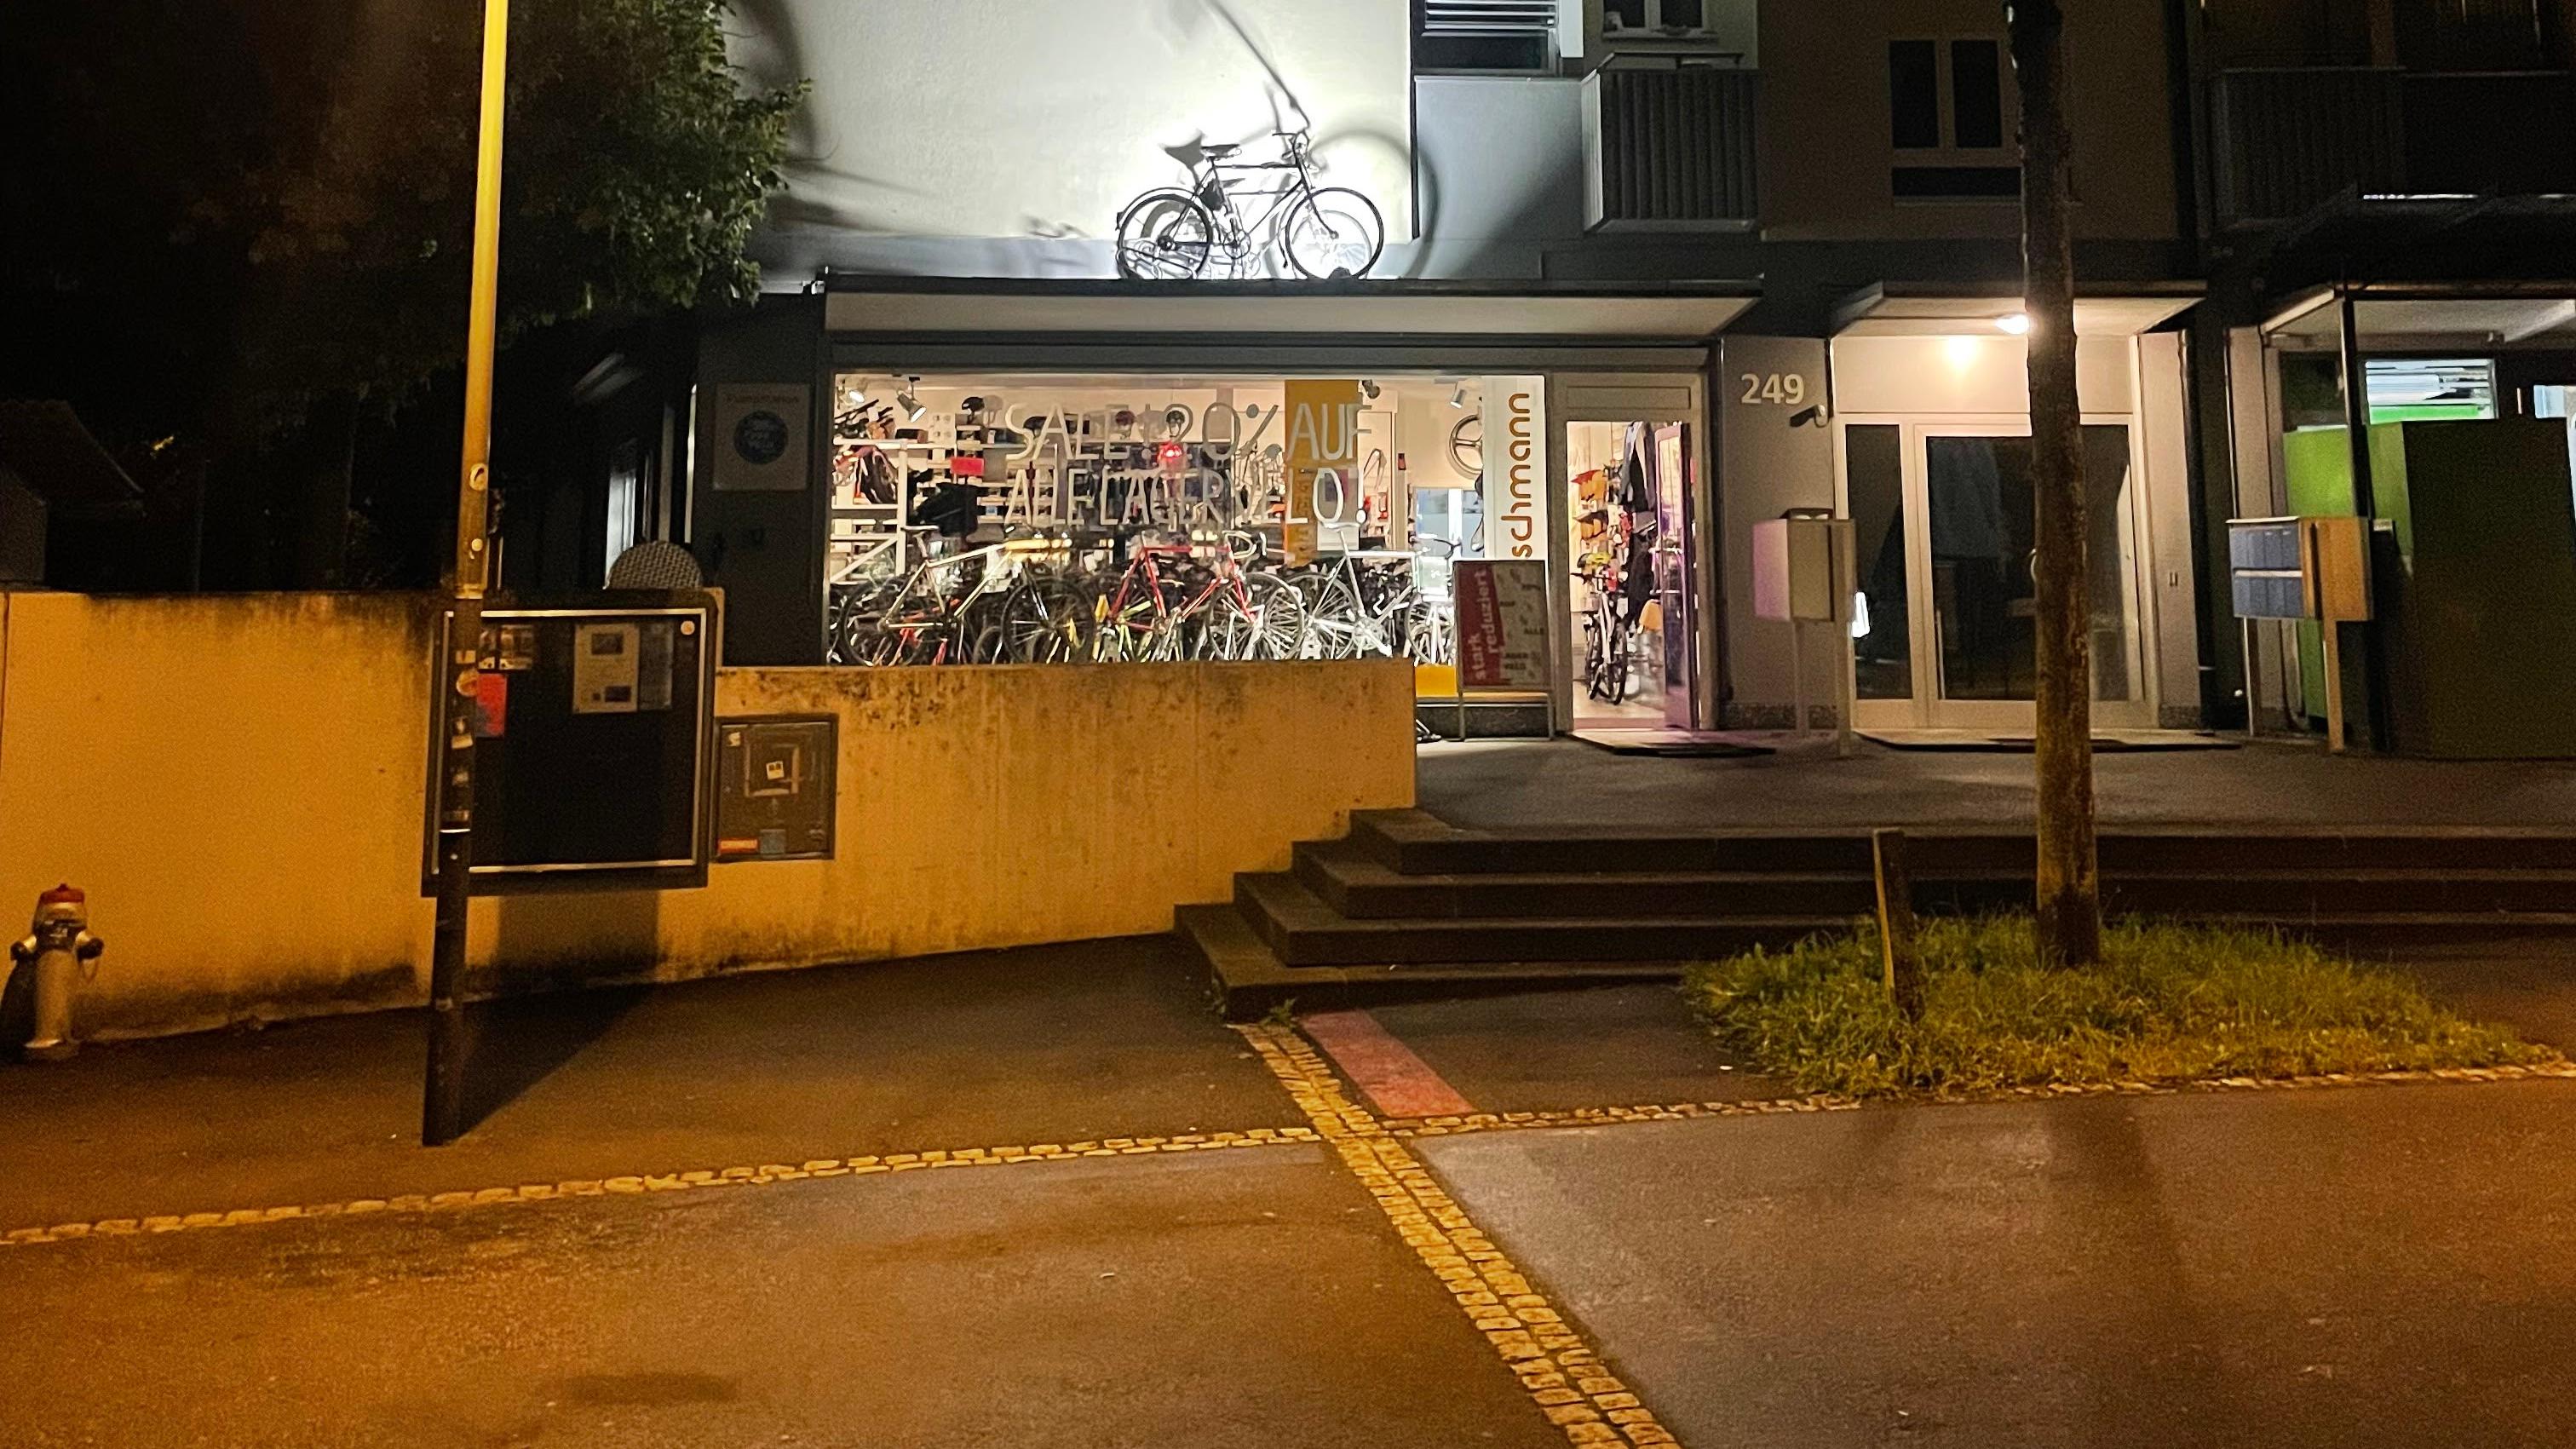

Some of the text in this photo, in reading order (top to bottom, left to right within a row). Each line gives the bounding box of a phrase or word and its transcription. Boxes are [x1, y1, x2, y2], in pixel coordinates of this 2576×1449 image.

[1741, 373, 1804, 404] 249
[1285, 402, 1373, 461] AUF
[1474, 566, 1498, 654] reduziert
[1467, 632, 1486, 681] stark
